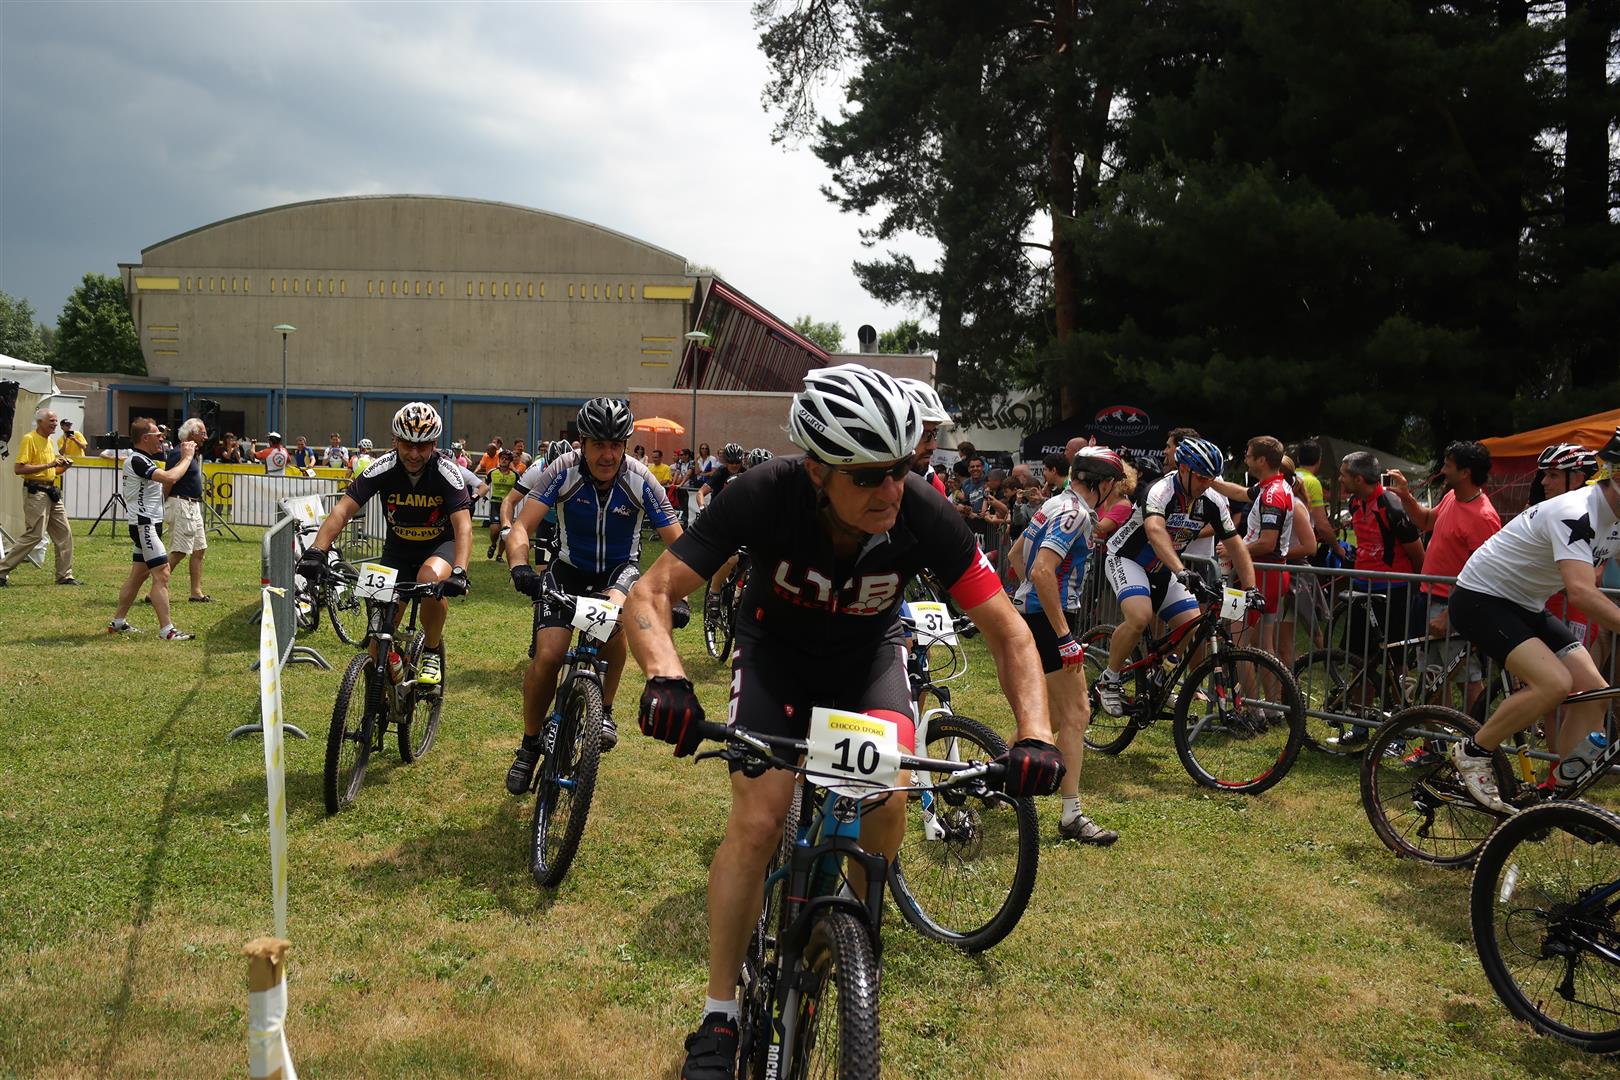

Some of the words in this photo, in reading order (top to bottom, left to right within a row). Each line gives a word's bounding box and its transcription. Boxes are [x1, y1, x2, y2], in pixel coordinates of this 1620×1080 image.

[805, 412, 826, 433] GIRO
[1041, 446, 1066, 454] ROC
[144, 525, 153, 551] GIANT
[365, 573, 386, 589] 13
[1231, 598, 1238, 610] 4
[585, 606, 608, 627] 24
[925, 613, 943, 631] 37
[830, 722, 860, 731] CHICCO
[548, 722, 559, 754] FOX
[831, 738, 880, 775] 10
